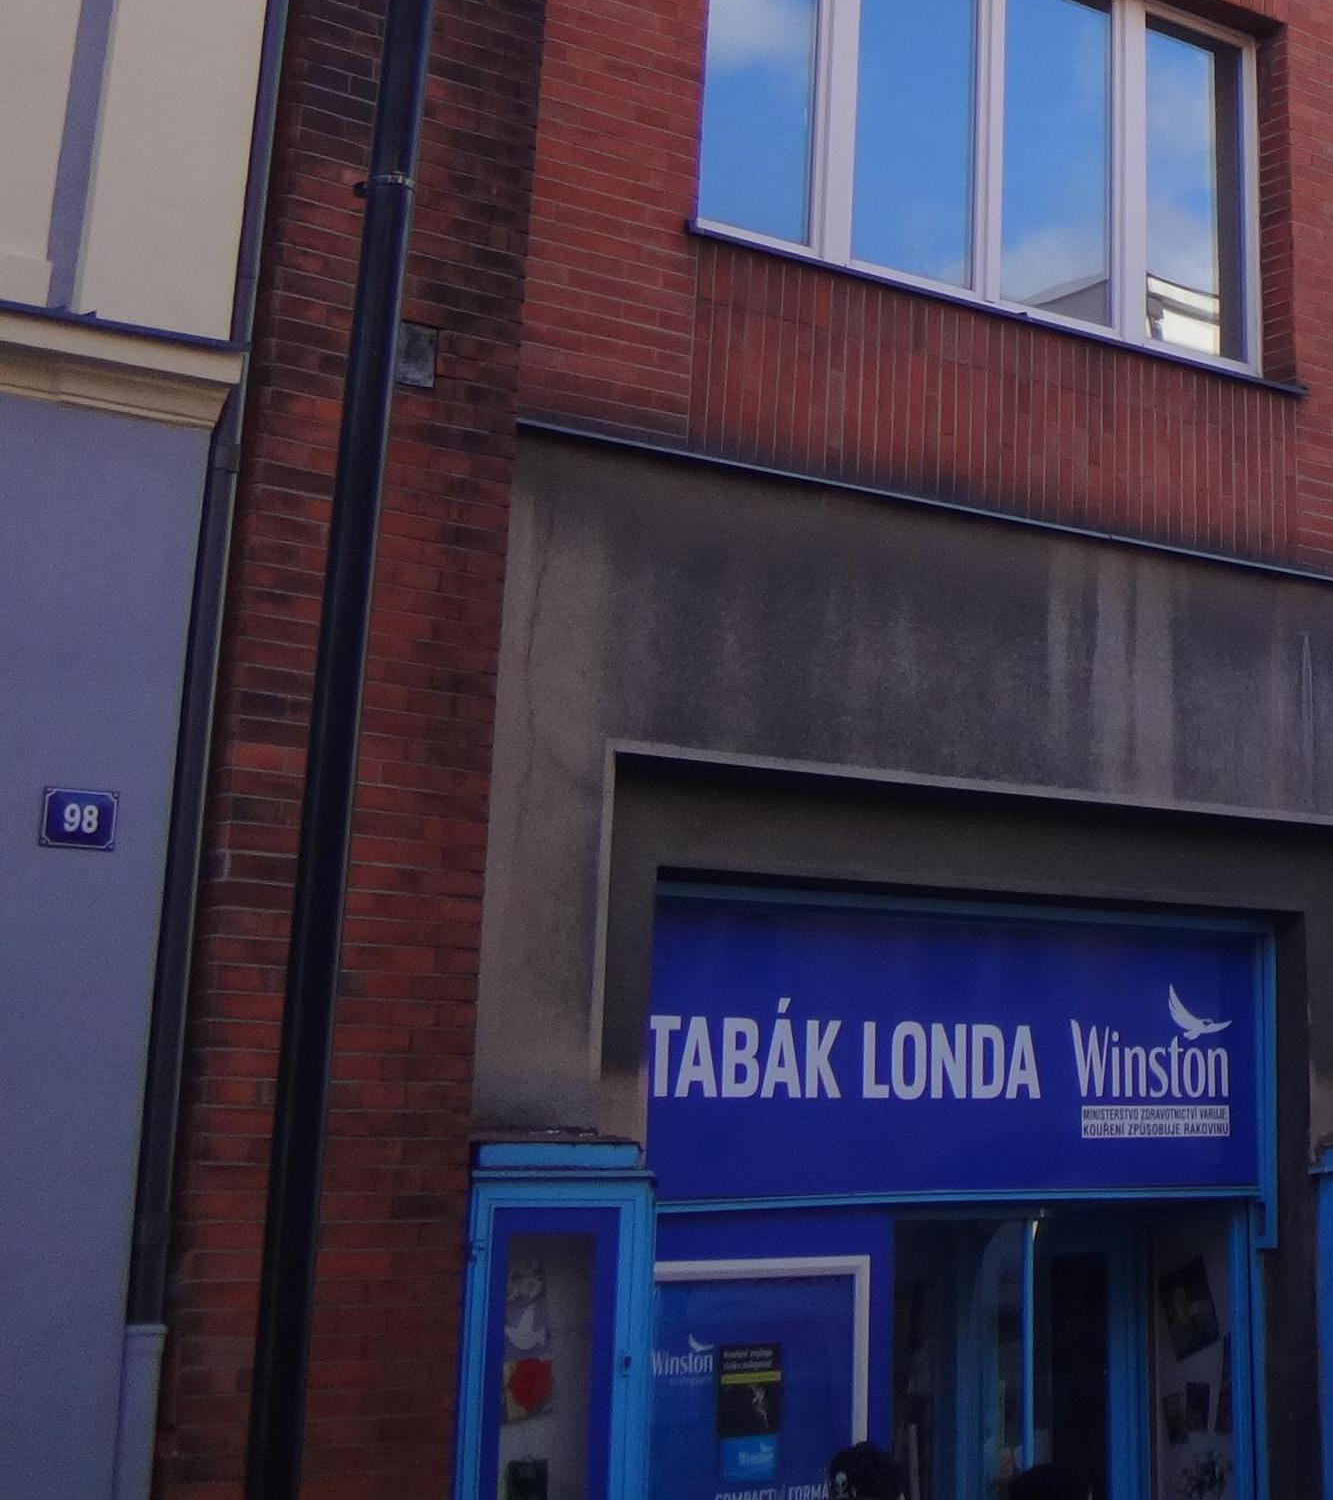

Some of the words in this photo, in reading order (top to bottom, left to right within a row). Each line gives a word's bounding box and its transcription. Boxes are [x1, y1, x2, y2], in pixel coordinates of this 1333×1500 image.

[63, 802, 99, 834] 98
[650, 997, 842, 1099] TABÁK
[862, 1020, 1042, 1100] LONDA
[1070, 1018, 1229, 1098] Winston
[1083, 1107, 1139, 1121] MINISTERSTVO
[1083, 1122, 1125, 1136] KOUŘENÍ
[1127, 1121, 1181, 1136] ZPŮSOBUJE
[1183, 1122, 1229, 1135] RAKOVINU
[652, 1351, 714, 1376] Winston
